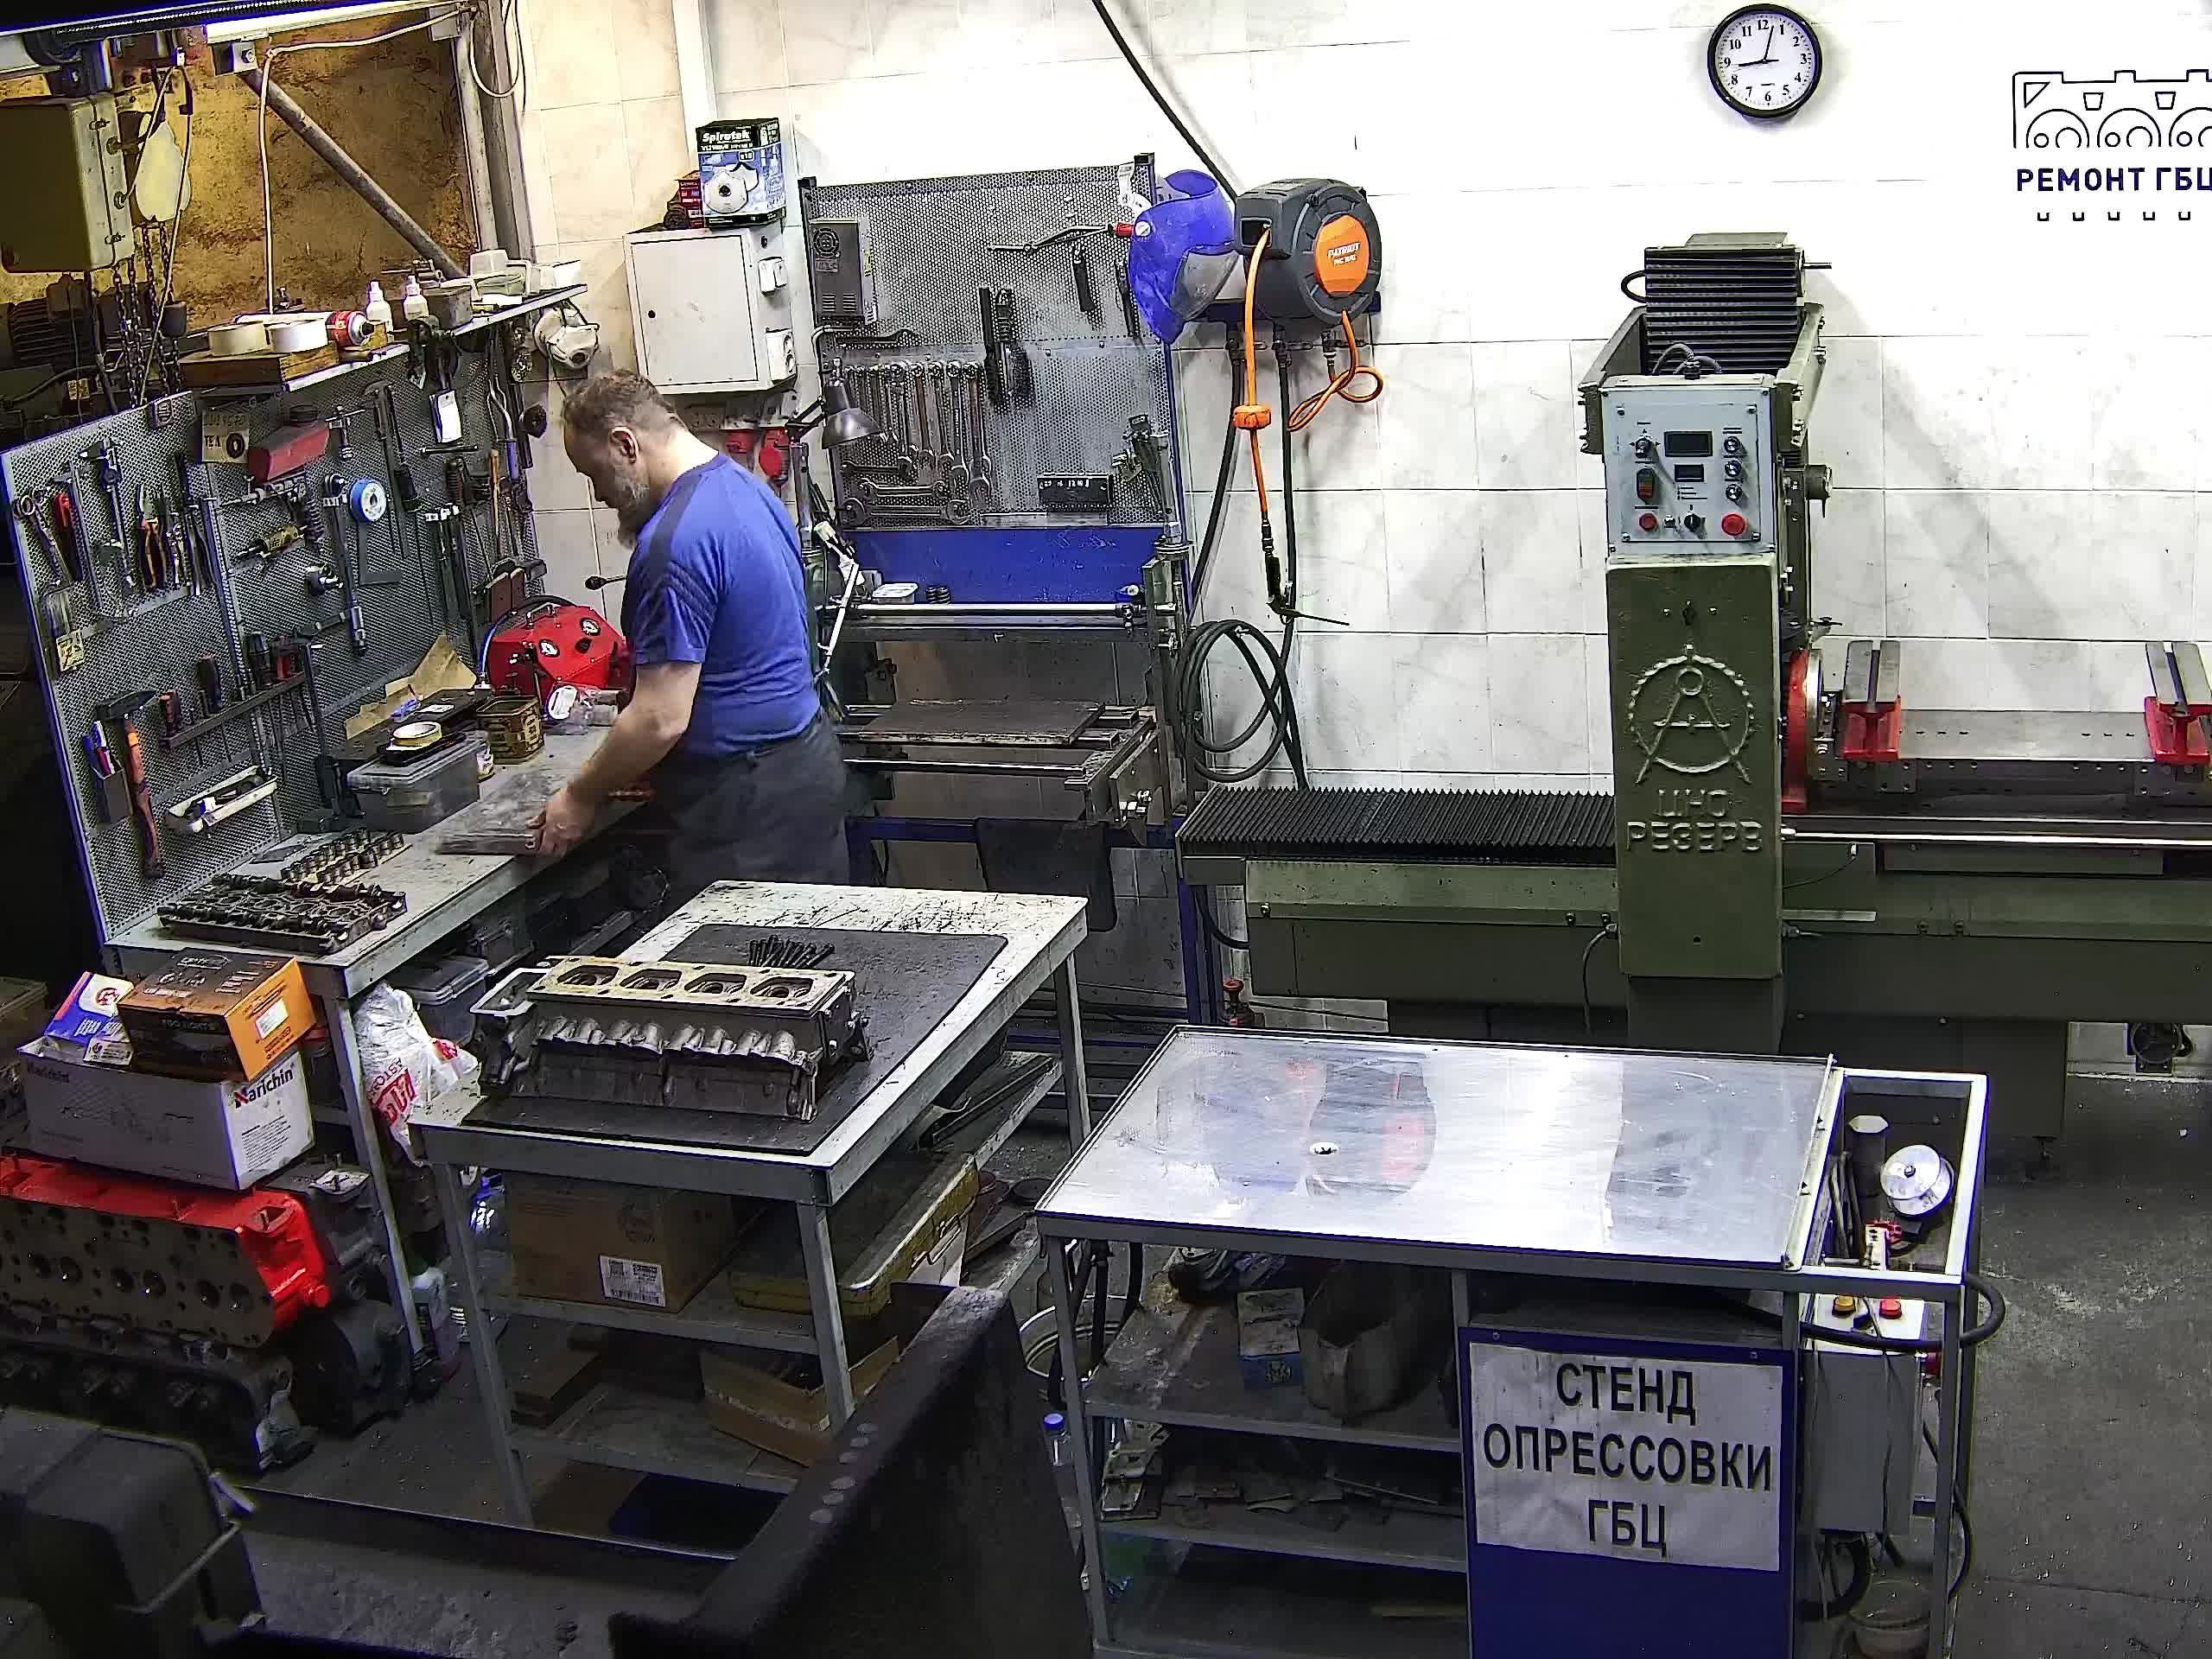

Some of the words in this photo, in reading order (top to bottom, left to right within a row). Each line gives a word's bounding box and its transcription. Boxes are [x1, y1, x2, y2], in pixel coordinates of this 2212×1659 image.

[1758, 19, 1770, 30] 12
[1780, 24, 1784, 35] 1
[1742, 25, 1751, 36] 11
[1729, 39, 1741, 49] 10
[1792, 36, 1800, 47] 2
[1724, 57, 1731, 67] 9
[1800, 53, 1807, 64] 3
[1731, 74, 1738, 85] 8
[1794, 72, 1801, 82] 4
[1745, 86, 1752, 97] 7
[1782, 85, 1789, 95] 5
[1764, 91, 1771, 101] 6
[2017, 167, 2145, 192] РЕМОНТ
[1627, 821, 1764, 850] РЕЗЕРВ
[1556, 1363, 1697, 1427] СТЕНД
[1484, 1423, 1772, 1492] ОПРЕССОВКИ
[1588, 1499, 1668, 1559] ГБЦ
